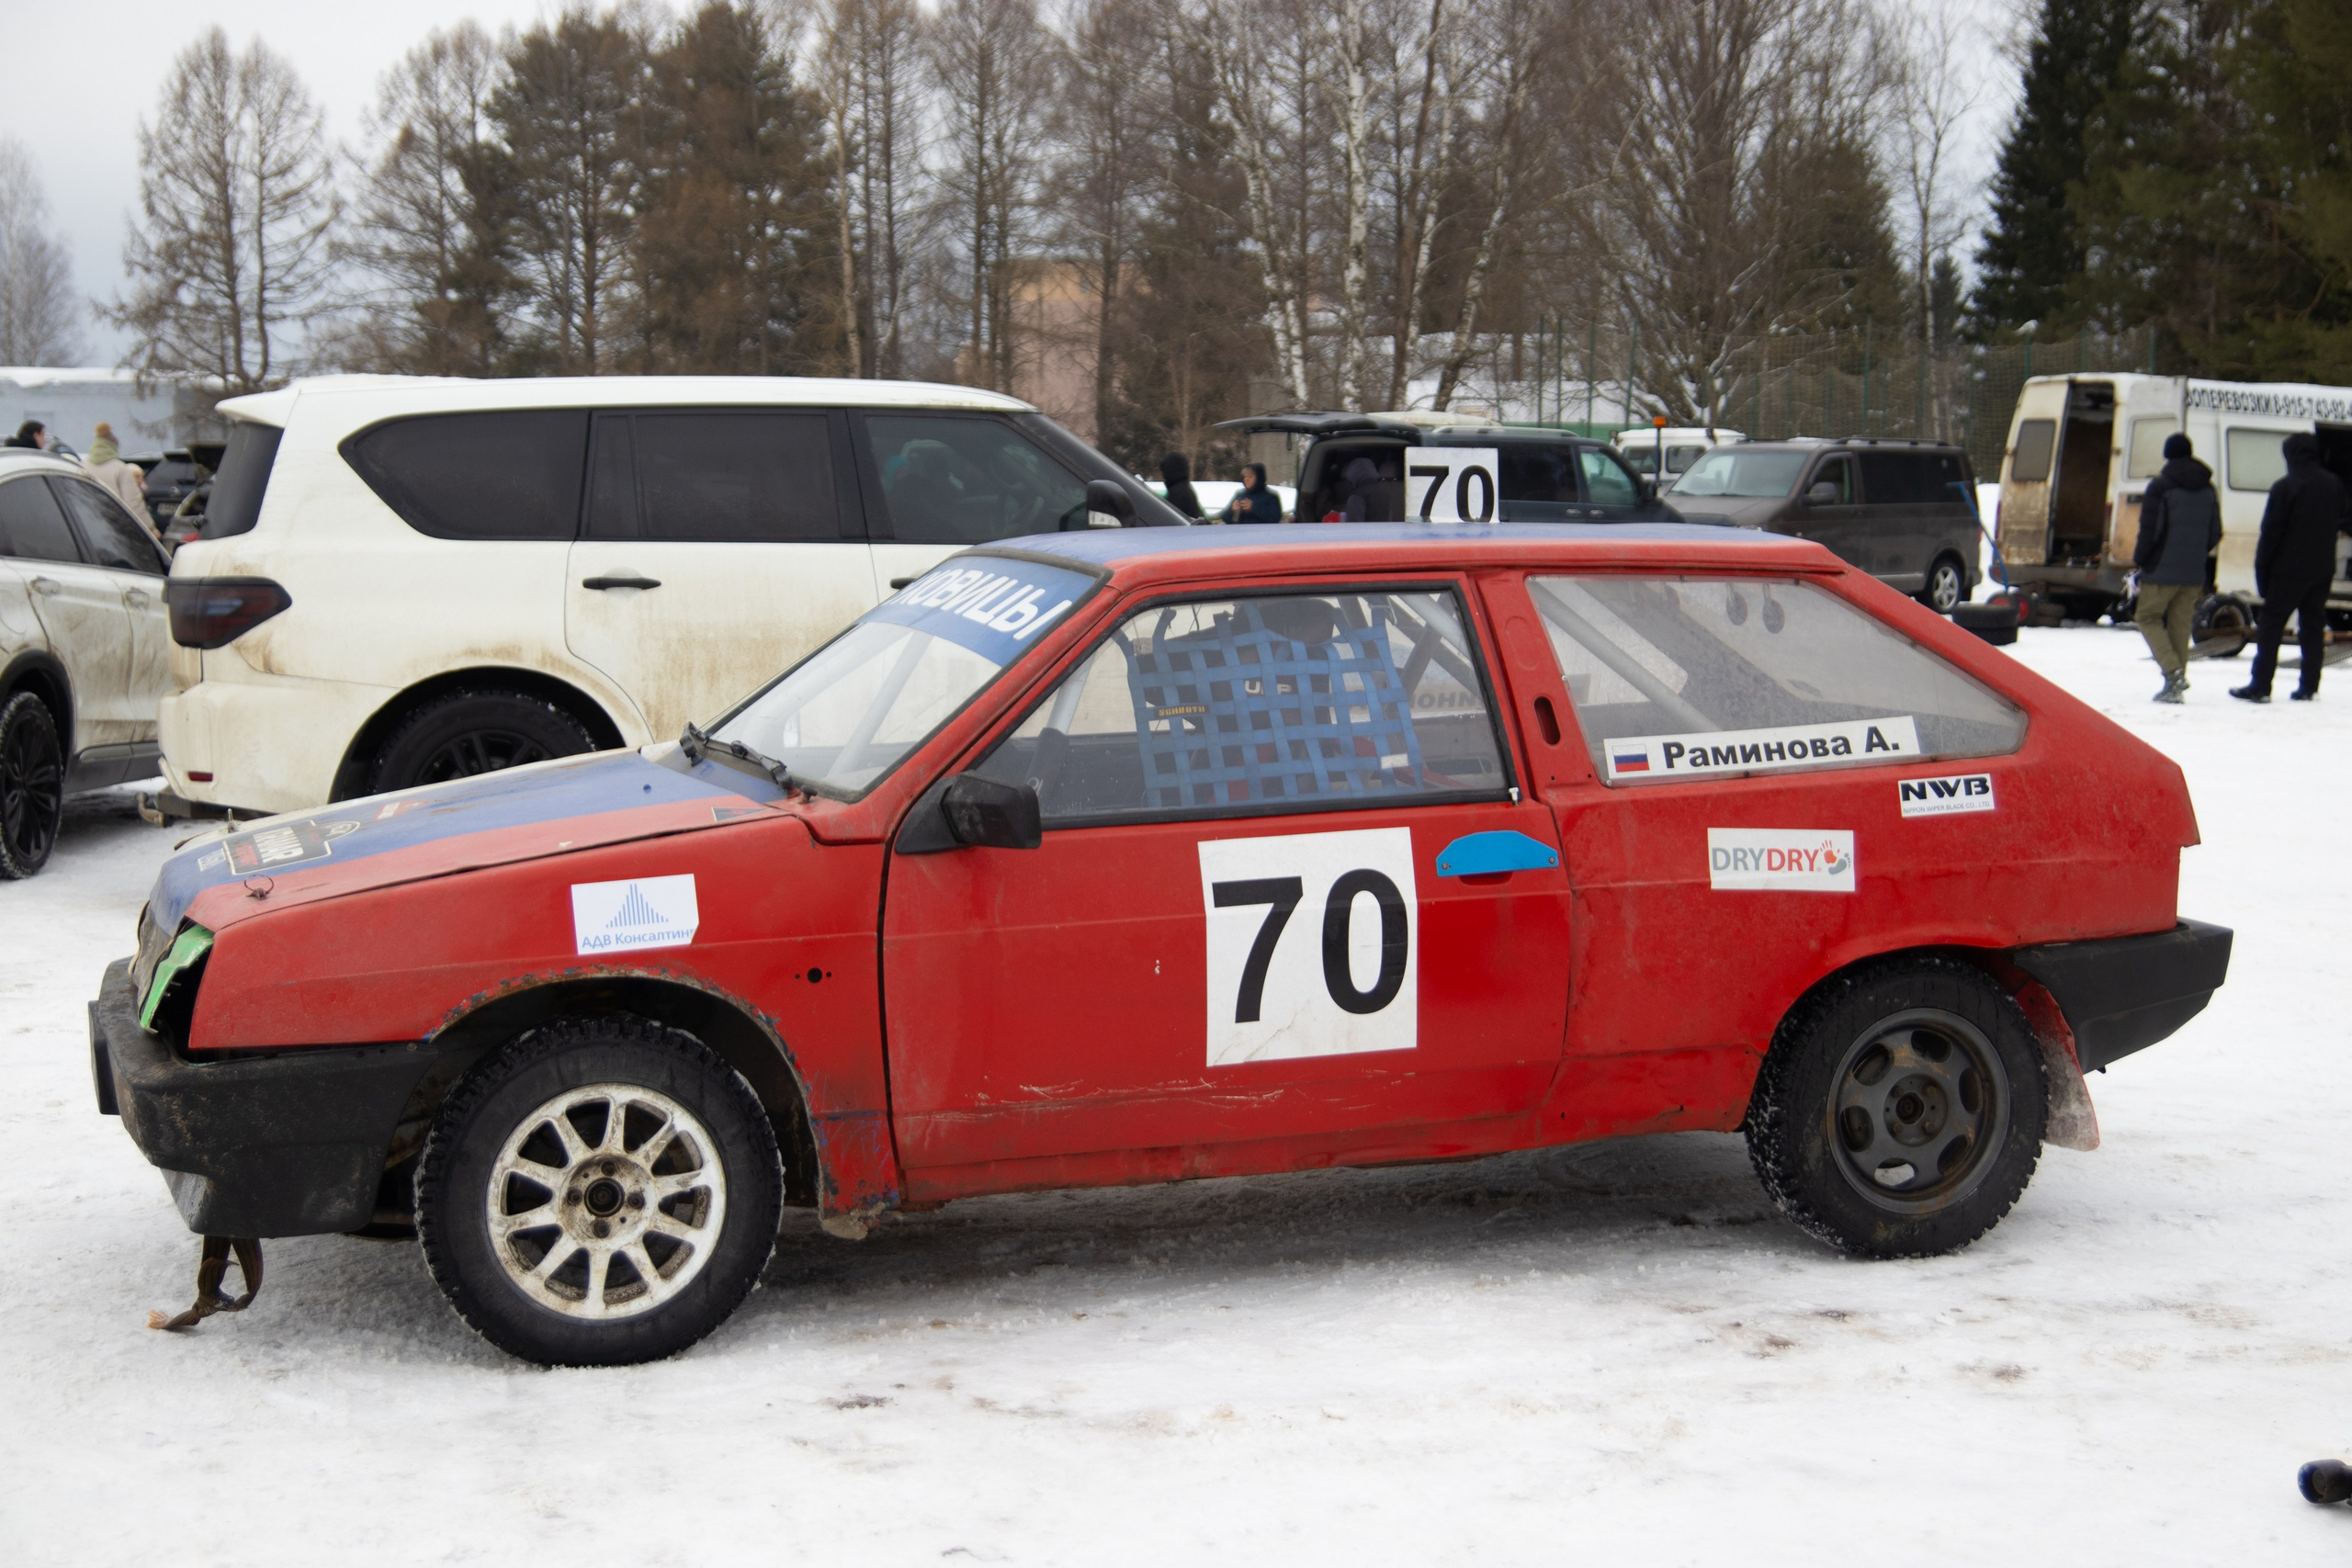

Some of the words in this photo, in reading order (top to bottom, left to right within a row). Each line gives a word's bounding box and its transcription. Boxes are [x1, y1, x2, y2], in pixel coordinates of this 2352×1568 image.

[1409, 465, 1495, 523] 70
[1662, 735, 1852, 770] Раминова
[1864, 726, 1900, 753] А.
[1901, 776, 1990, 801] NWB
[1926, 804, 1945, 812] WIPER
[582, 934, 612, 949] АДВ
[1211, 868, 1408, 1023] 70
